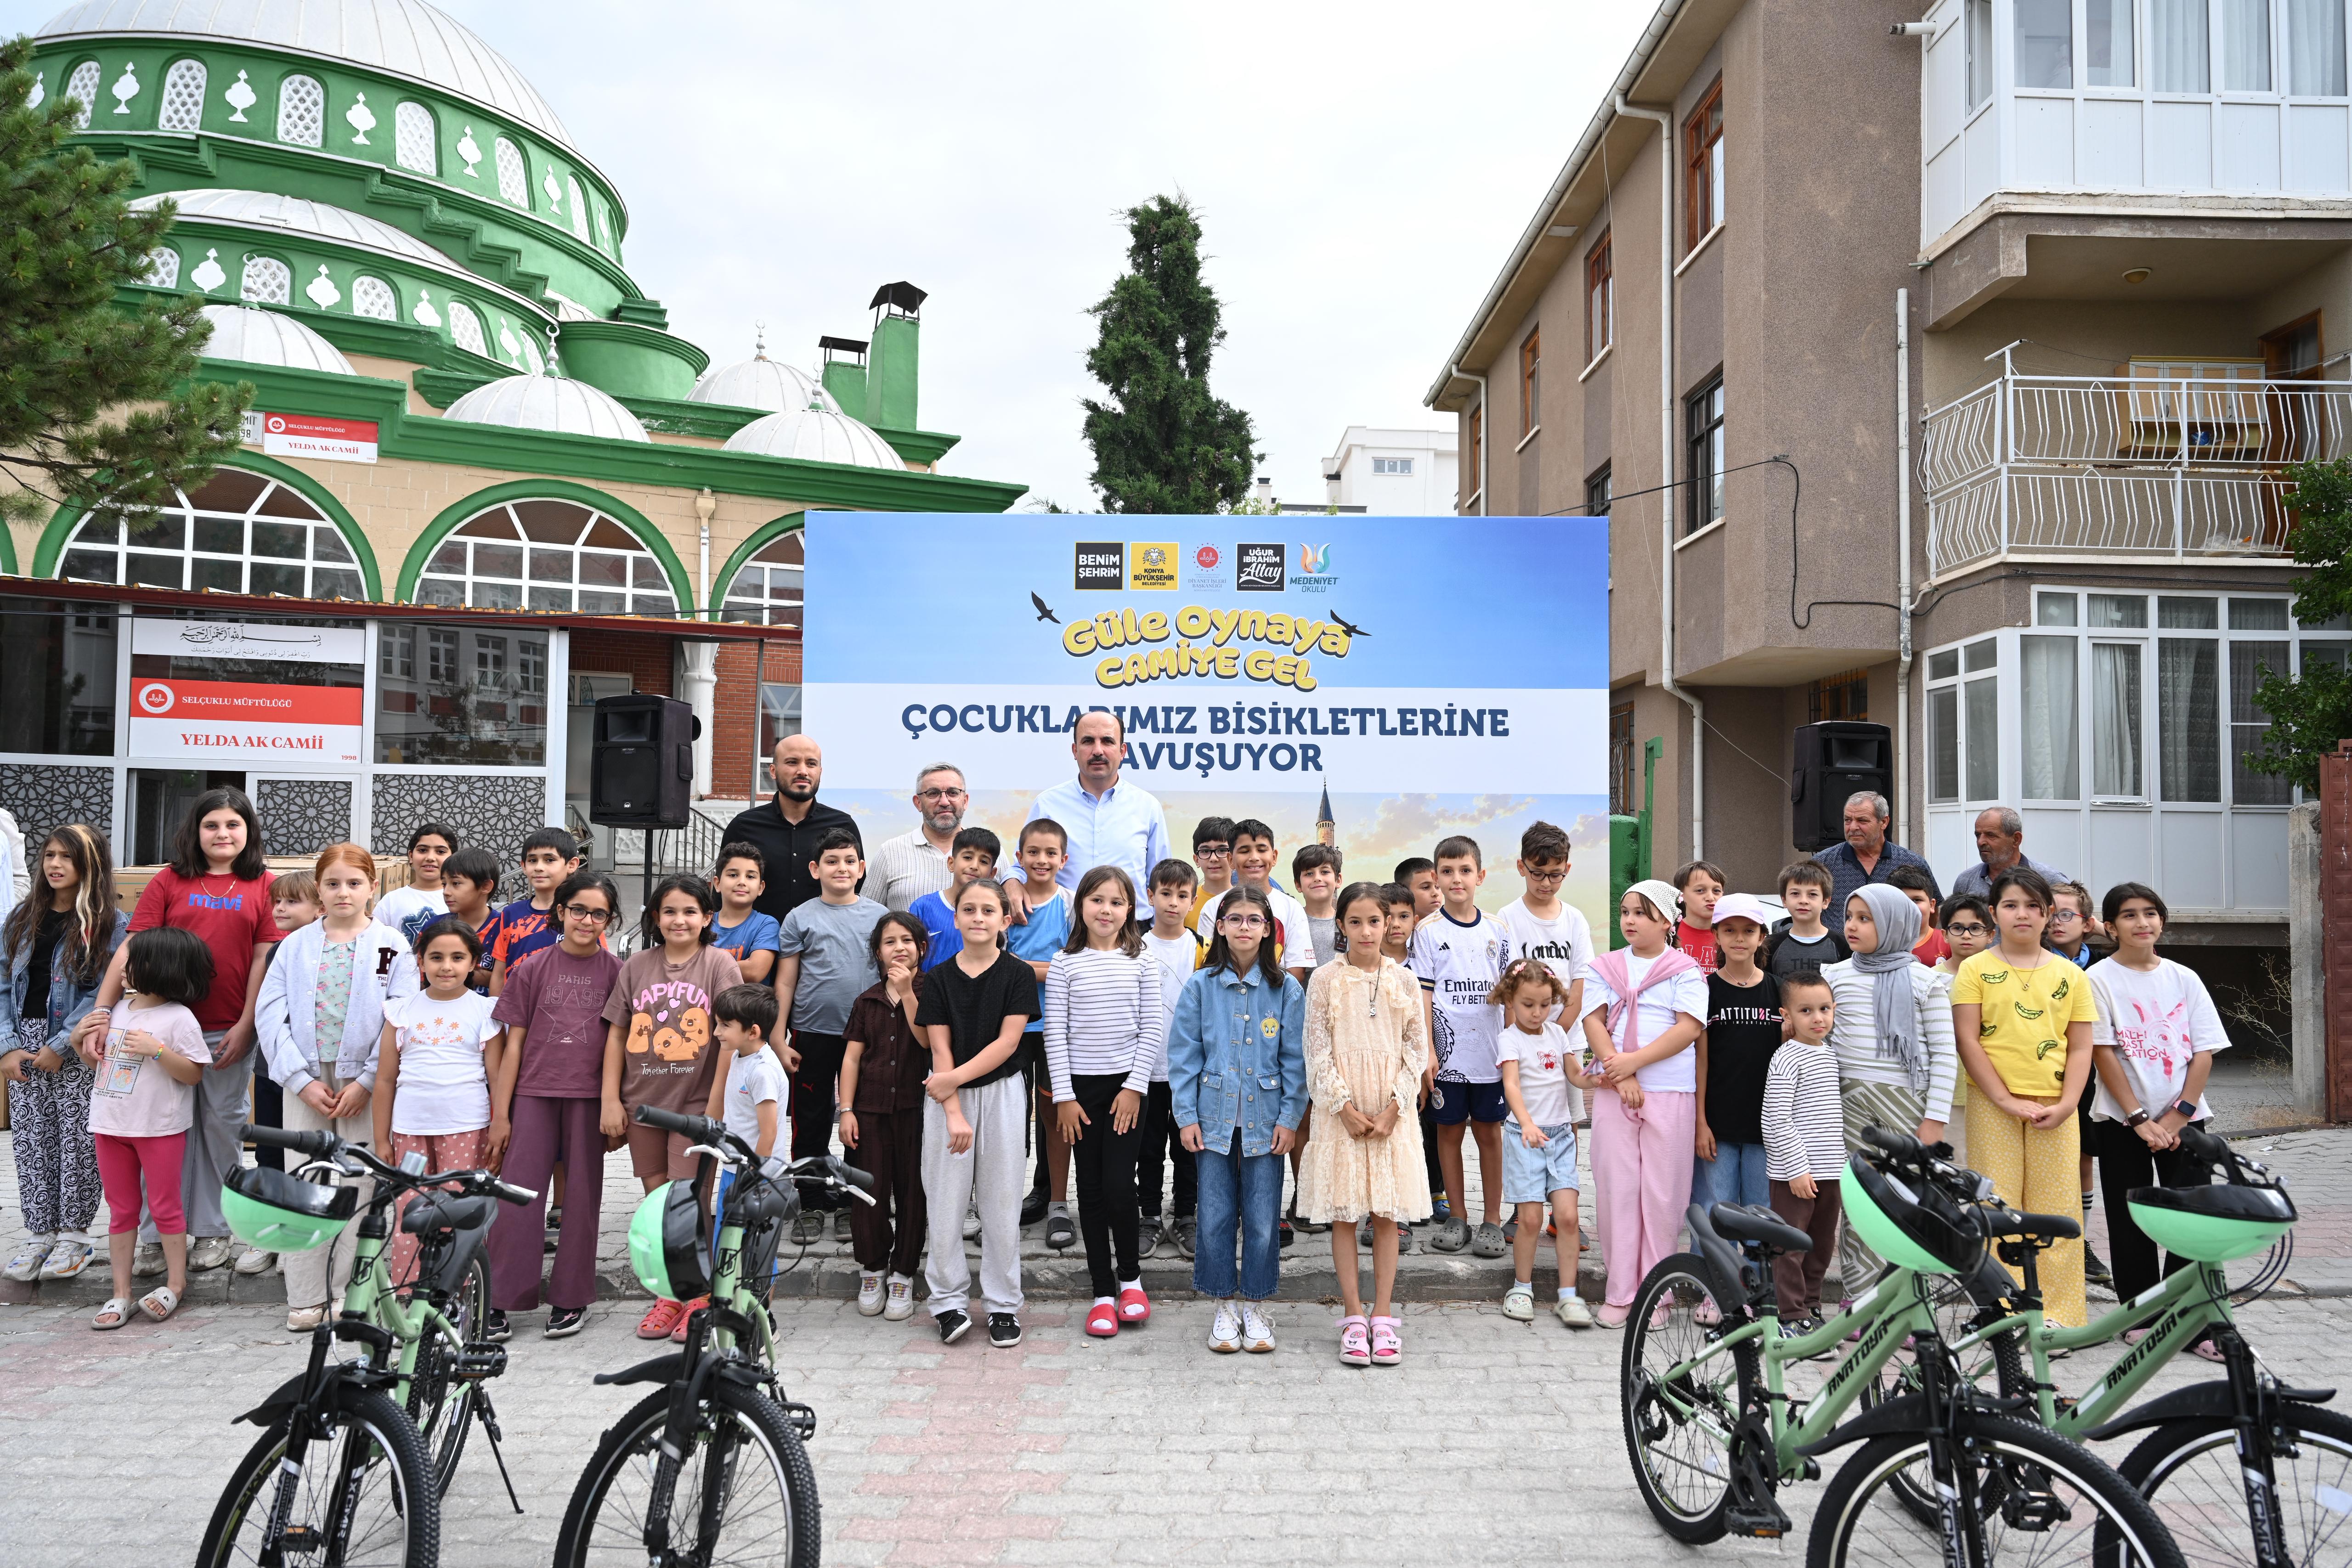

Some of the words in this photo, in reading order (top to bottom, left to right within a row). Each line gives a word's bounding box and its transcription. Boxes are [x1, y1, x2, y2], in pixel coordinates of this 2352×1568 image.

[288, 442, 316, 451] YELDA
[332, 446, 359, 454] CAMİİ
[1249, 547, 1273, 556] UĞUR
[1133, 574, 1174, 582] BÜYÜKŞEHİR
[1239, 563, 1282, 582] Altay
[1063, 607, 1170, 657] Güle
[1176, 605, 1351, 657] Oynaya
[1244, 649, 1317, 692] GEL
[182, 696, 232, 706] SELÇUKLU
[233, 697, 292, 708] MÜFTÜLÜĞÜ
[902, 704, 1197, 739] ÇOCUKLAIMIZ
[1209, 701, 1510, 737] BİSİKLETLERİNE
[181, 733, 240, 747] YELDA
[243, 736, 268, 748] AK
[271, 735, 324, 750] CAMİİ
[1119, 742, 1323, 778] AVUŞUYOR
[188, 893, 243, 911] mavi
[1305, 950, 1316, 959] MAR
[1791, 958, 1821, 970] THE
[558, 974, 592, 985] PARIS
[1452, 995, 1466, 1004] FLY
[1469, 995, 1488, 1004] BETT
[1720, 1007, 1770, 1021] ATTITUDE
[2118, 1039, 2143, 1049] OAST
[2124, 1048, 2169, 1058] CATION
[641, 1063, 668, 1077] Together
[670, 1063, 695, 1074] Forever
[2106, 1312, 2177, 1390] ANATOYA
